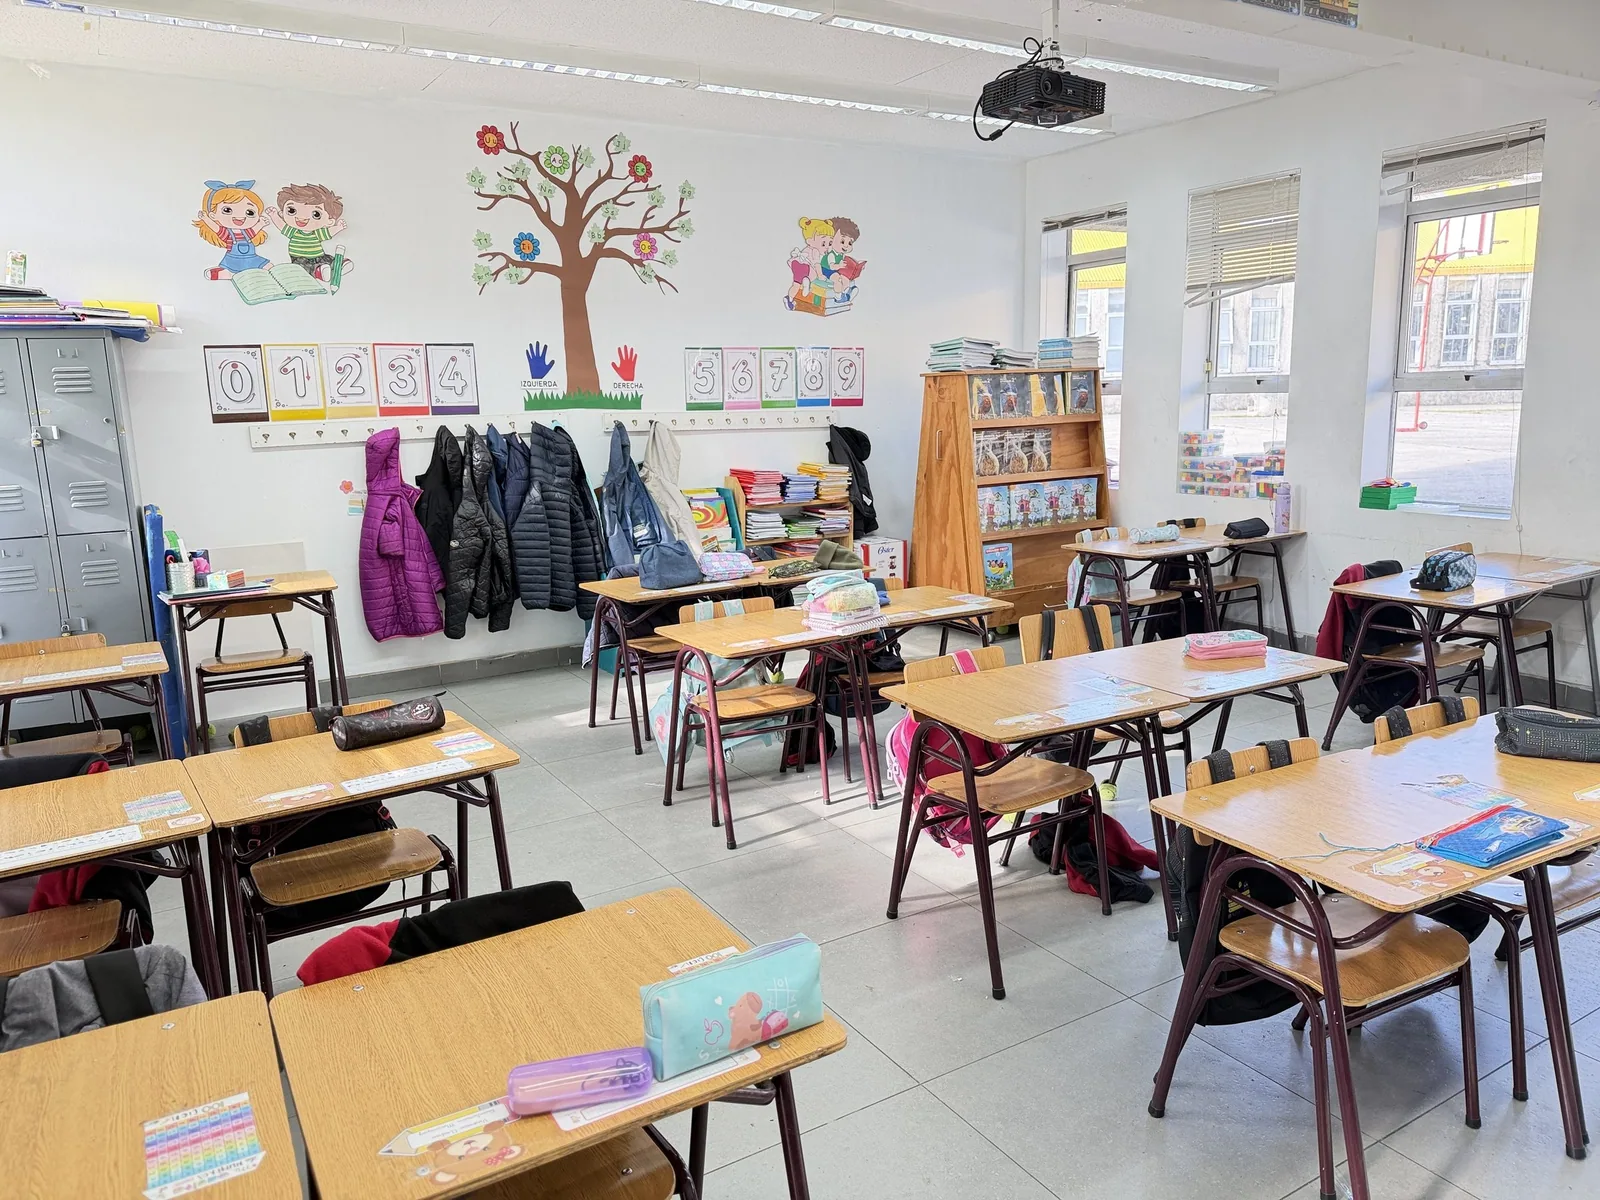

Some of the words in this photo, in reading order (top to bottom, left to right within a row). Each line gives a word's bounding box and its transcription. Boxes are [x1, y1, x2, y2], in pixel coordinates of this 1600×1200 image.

[220, 360, 253, 403] 0
[280, 356, 307, 398] 1
[335, 356, 365, 395] 2
[388, 357, 417, 396] 3
[439, 355, 468, 396] 4
[520, 380, 558, 388] IZQUIERDA
[694, 360, 715, 394] 5
[732, 359, 753, 393] 6
[769, 359, 788, 392] 7
[804, 358, 824, 391] 8
[837, 358, 857, 391] 9
[877, 546, 895, 555] Oster
